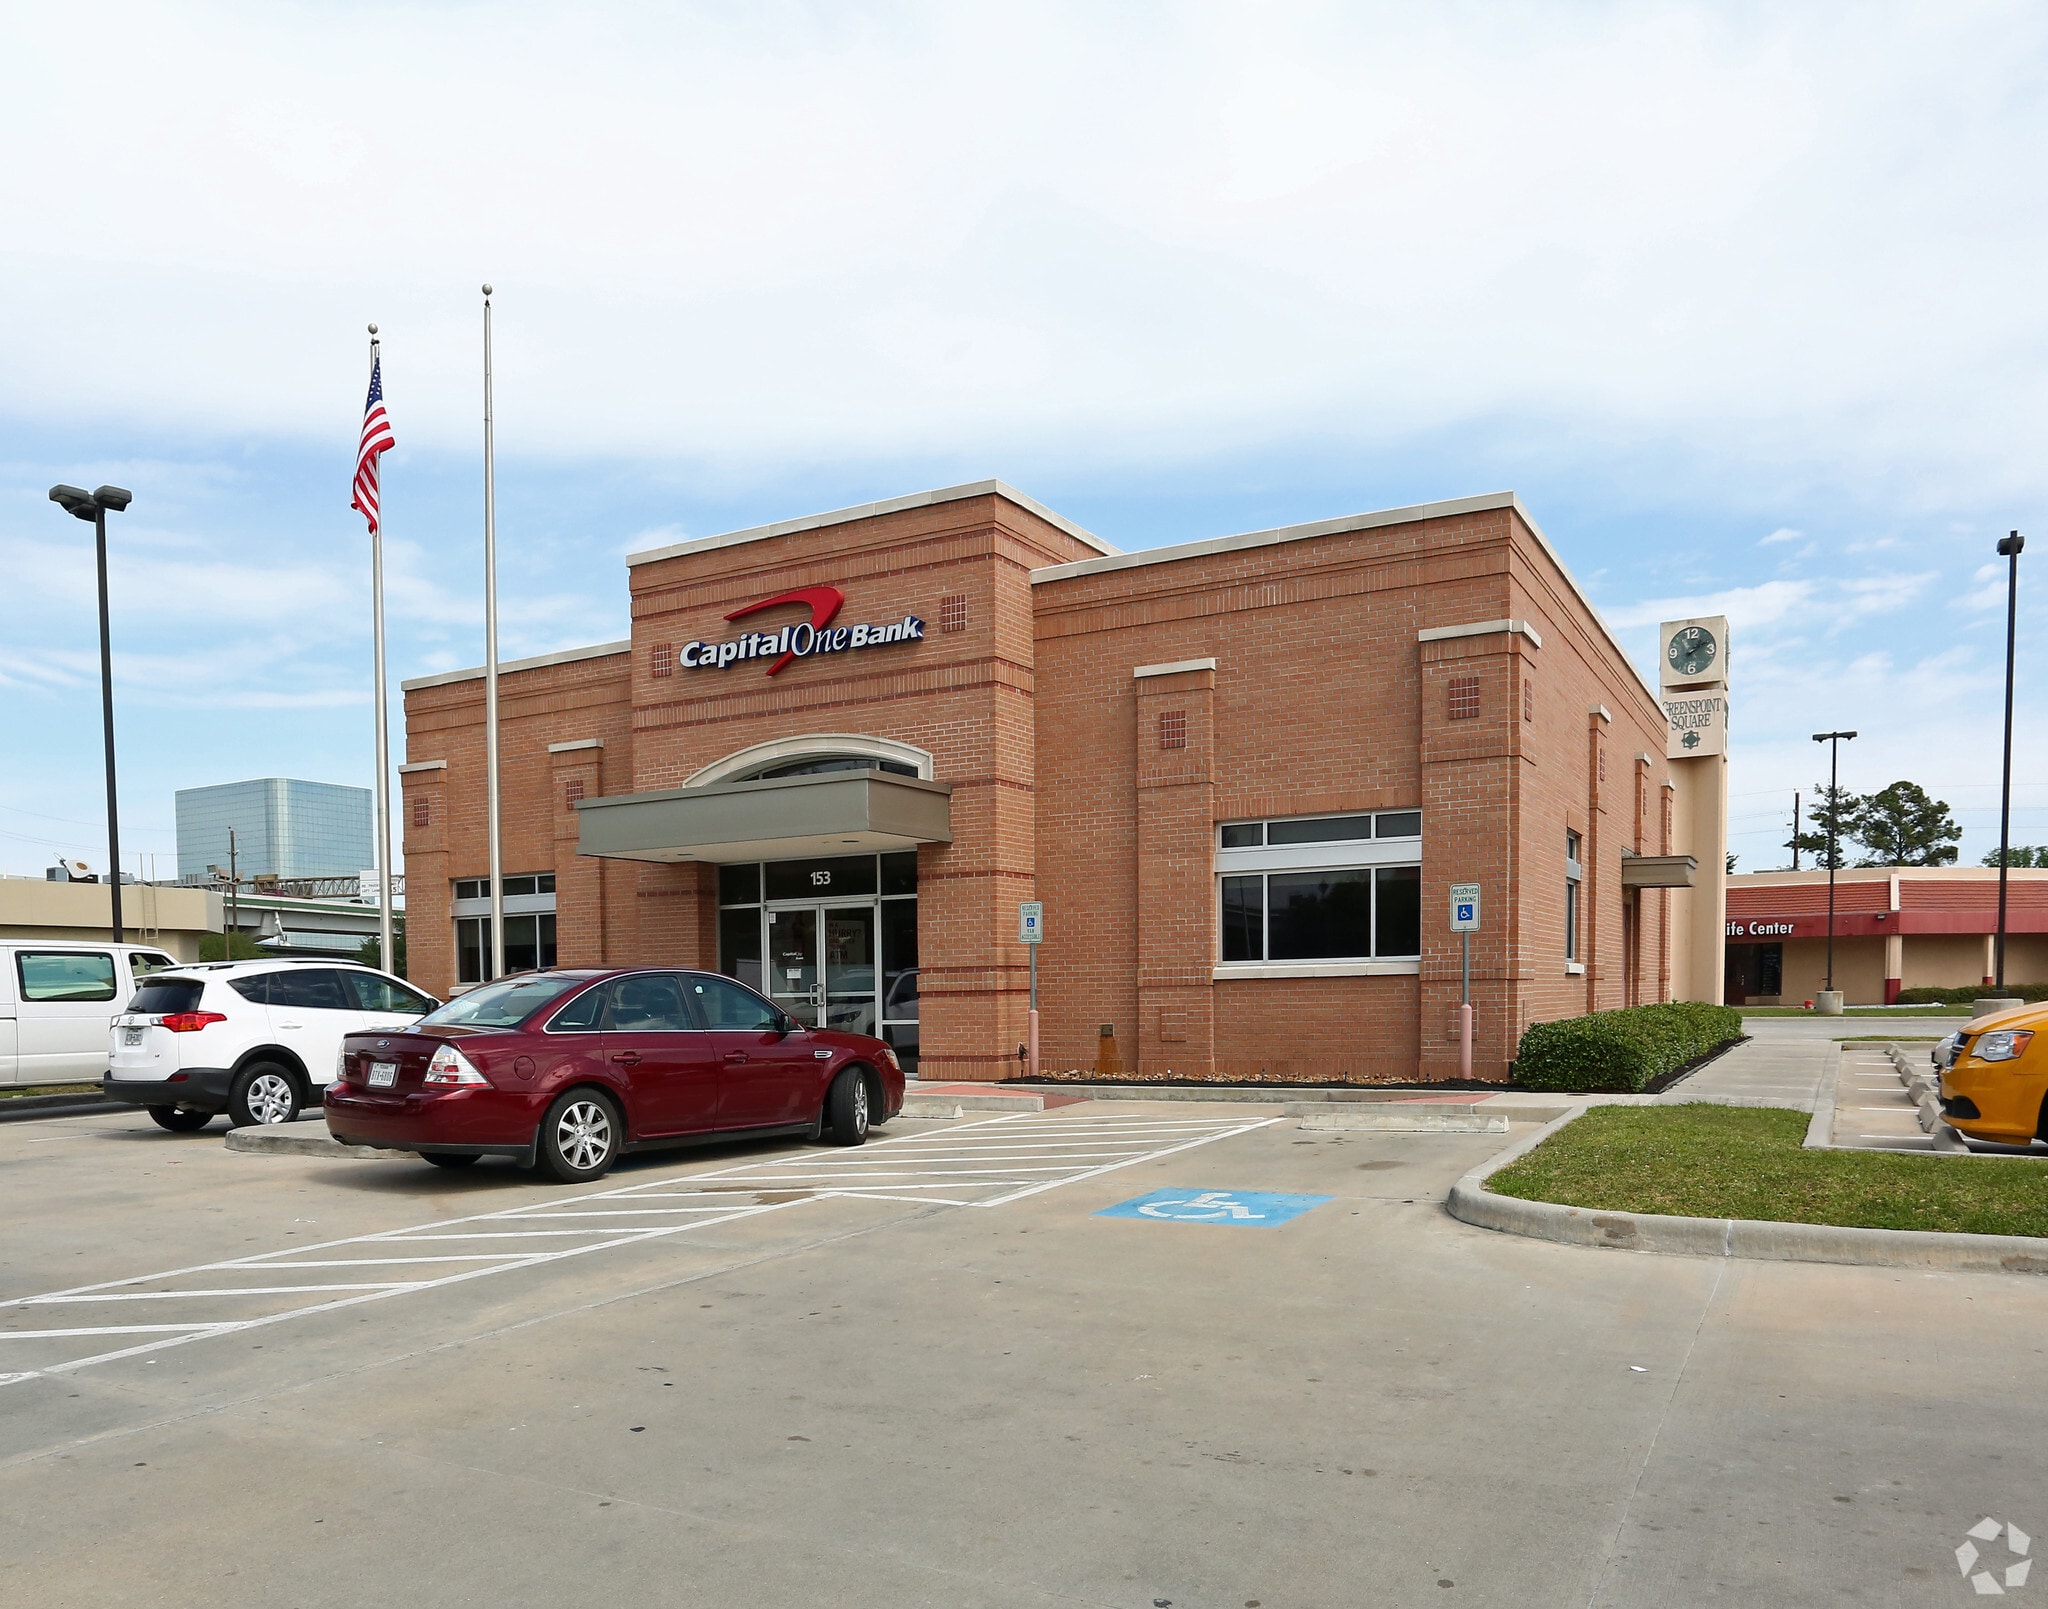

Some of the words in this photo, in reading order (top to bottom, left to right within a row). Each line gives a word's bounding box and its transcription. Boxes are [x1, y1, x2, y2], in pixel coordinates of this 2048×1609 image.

[849, 615, 926, 649] Bank
[1685, 628, 1699, 640] 12
[1669, 647, 1678, 659] 9
[1706, 643, 1715, 655] 3
[1687, 662, 1696, 674] 6
[1671, 713, 1712, 731] SQUARE
[810, 871, 831, 885] 153
[1452, 887, 1478, 895] RESERVED
[1726, 921, 1744, 936] ife
[1749, 921, 1794, 935] Center
